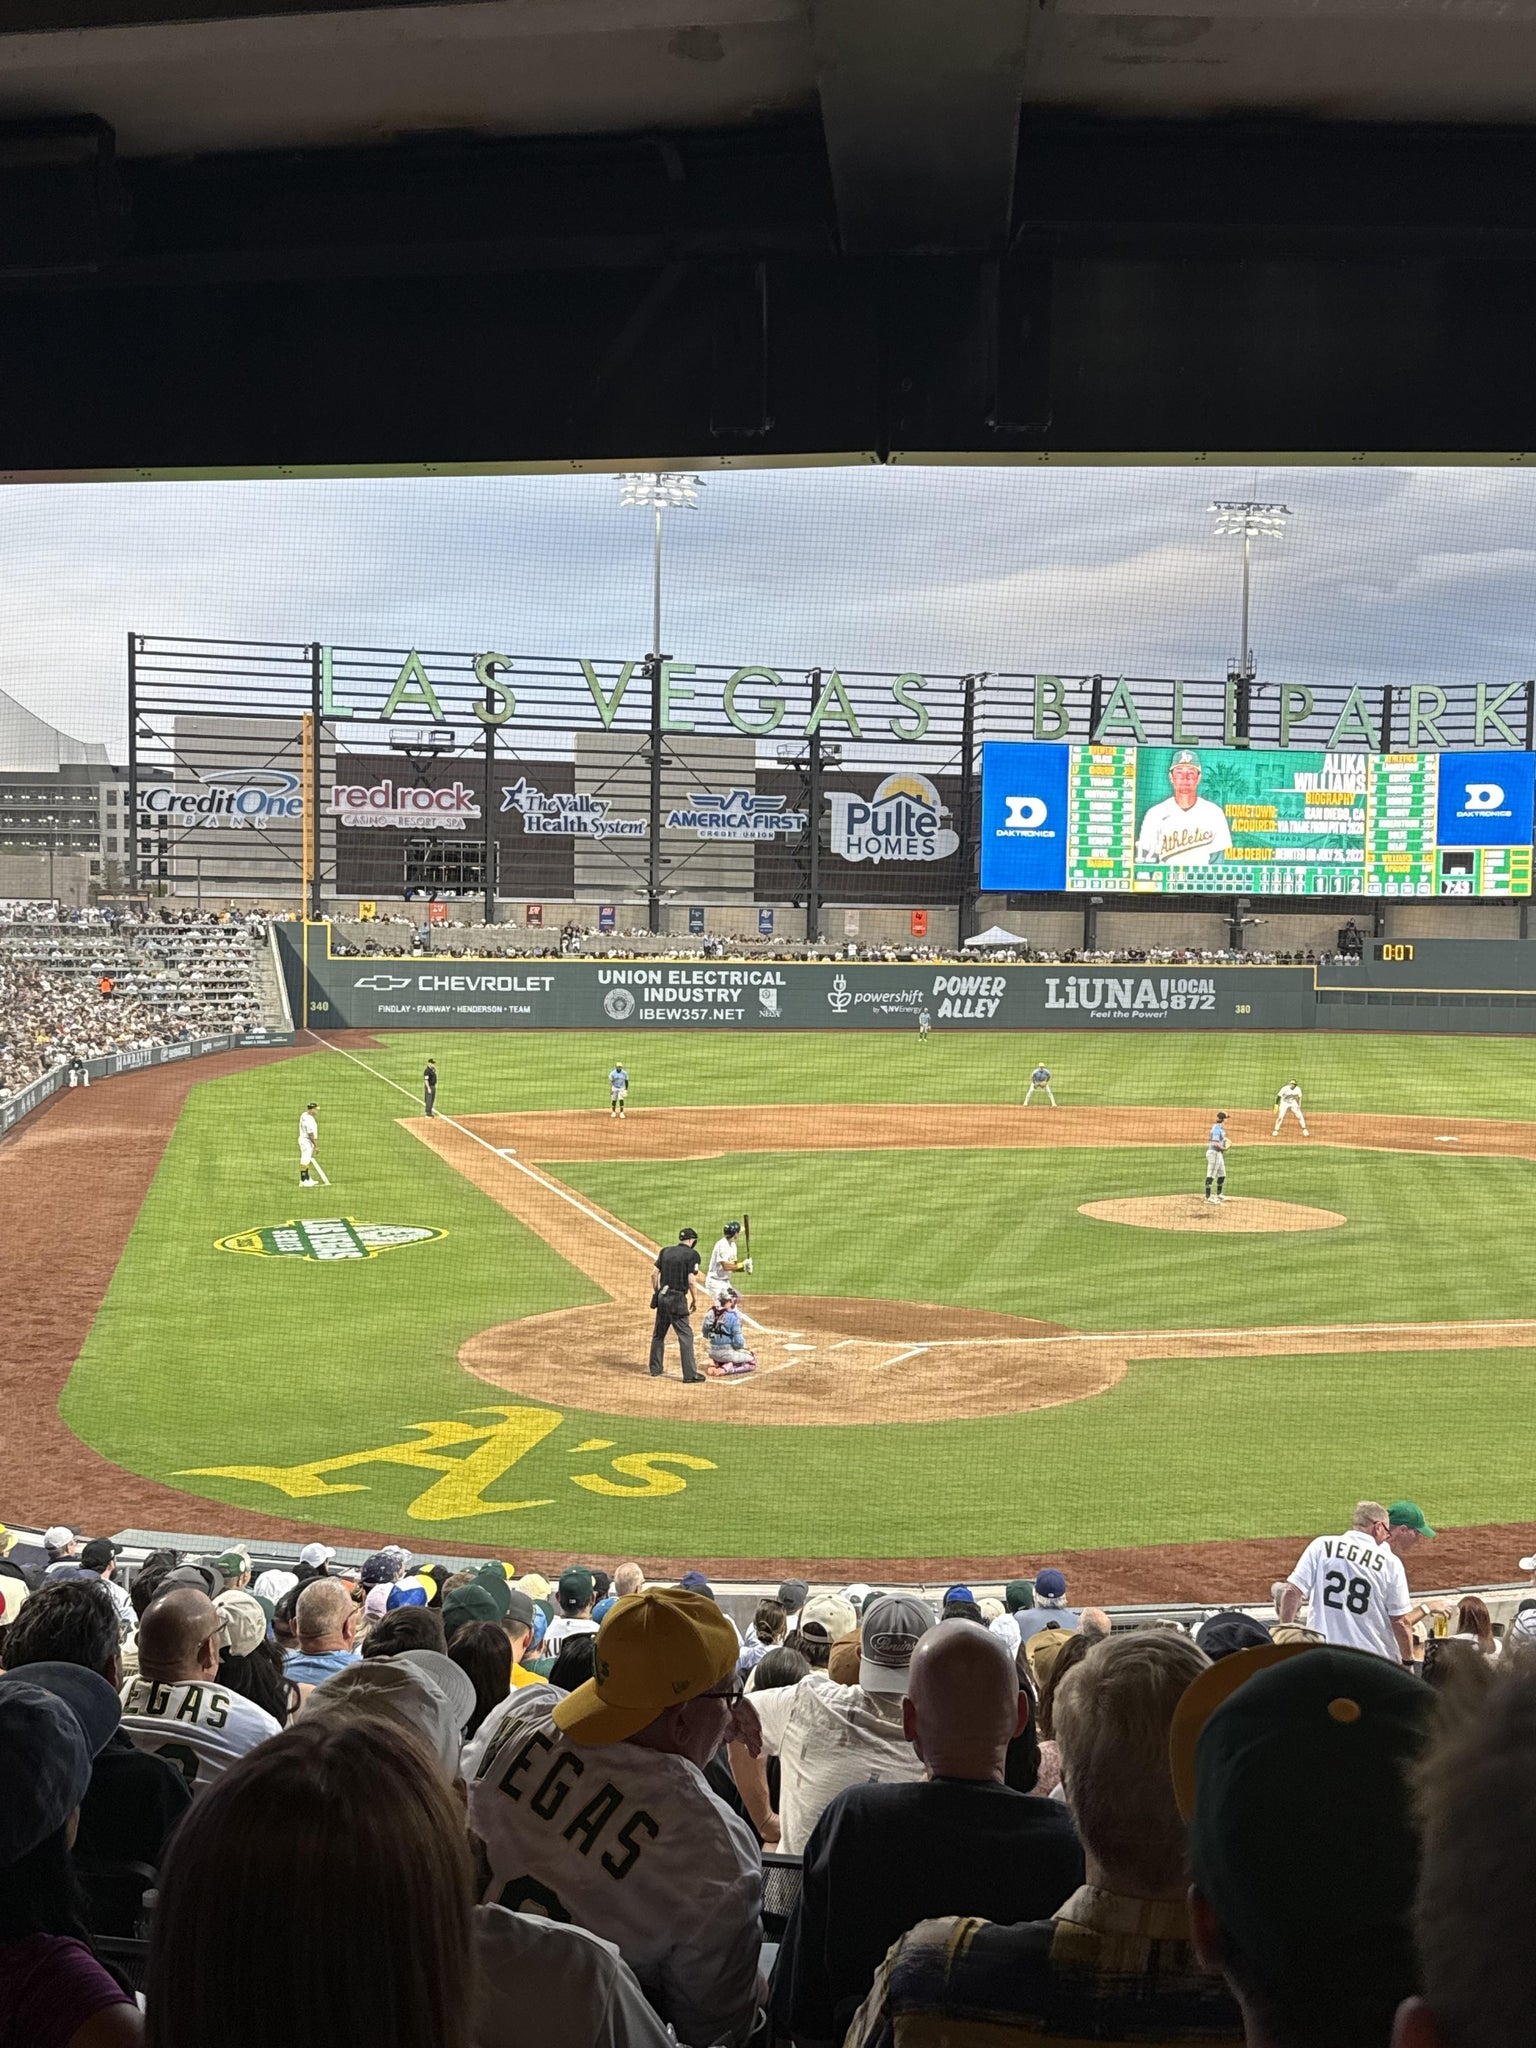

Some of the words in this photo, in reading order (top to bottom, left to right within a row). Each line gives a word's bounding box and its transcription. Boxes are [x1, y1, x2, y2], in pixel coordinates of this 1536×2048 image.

[322, 646, 517, 725] LAS
[579, 658, 929, 740] VEGAS
[1033, 675, 1525, 750] BALLPARK
[1323, 754, 1366, 774] ALIKA
[1294, 772, 1366, 791] WILLIAMS
[334, 782, 390, 808] red
[400, 784, 474, 810] rock
[1305, 792, 1355, 805] BIOGRAPHY
[526, 795, 556, 811] The
[556, 795, 609, 817] Valley
[1456, 810, 1512, 818] DAKTRONICS
[185, 814, 268, 828] BANK
[344, 814, 387, 825] CASINO
[399, 816, 436, 826] RESORT
[445, 817, 465, 827] SPA
[527, 816, 589, 832] Health
[590, 818, 643, 837] System
[668, 812, 750, 828] AMERICA
[753, 816, 805, 829] FIRST
[847, 800, 938, 837] Pulte
[996, 829, 1056, 838] DAKTRONICS
[1160, 828, 1214, 855] Athletics
[847, 837, 935, 856] HOMES
[1225, 848, 1243, 860] MLB
[1383, 944, 1414, 961] 0:07
[418, 976, 555, 992] CHEVROLET
[598, 970, 662, 984] UNION
[668, 970, 786, 985] ELECTRICAL
[932, 975, 1007, 997] POWER
[644, 988, 742, 1002] INDUSTRY
[1045, 975, 1169, 1010] LiUNA!
[1170, 979, 1216, 994] LOCAL
[854, 989, 924, 1005] powershift
[1170, 994, 1216, 1010] 872
[310, 1001, 329, 1011] 340
[378, 1005, 411, 1013] FINDLAY
[417, 1005, 451, 1013] FAIRWAY
[457, 1005, 503, 1013] HENDERSON
[509, 1005, 531, 1013] TEAM
[639, 1008, 745, 1020] IBEW357.NET
[872, 1006, 880, 1014] by
[937, 998, 1000, 1018] ALLEY
[1090, 1010, 1111, 1018] Feel
[1113, 1010, 1129, 1018] the
[1132, 1010, 1168, 1018] Power!
[1235, 1005, 1251, 1014] 380
[163, 1405, 718, 1520] A's
[1324, 1540, 1386, 1571] VEGAS
[1324, 1570, 1371, 1615] 28
[123, 1677, 231, 1729] EGAS
